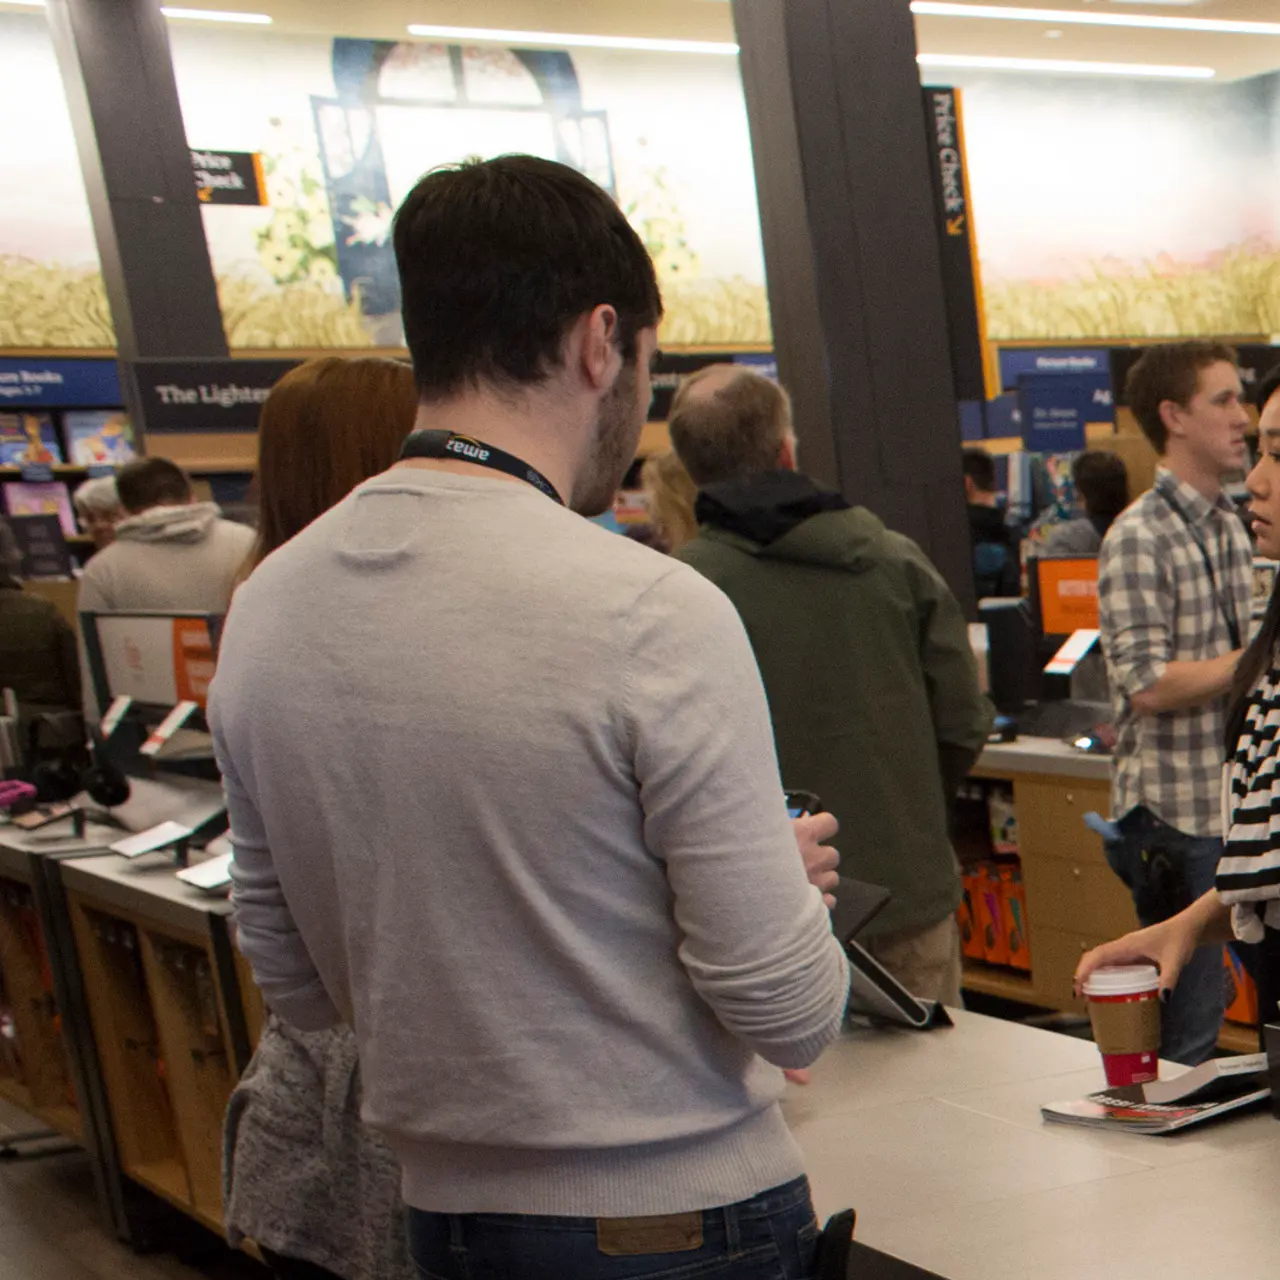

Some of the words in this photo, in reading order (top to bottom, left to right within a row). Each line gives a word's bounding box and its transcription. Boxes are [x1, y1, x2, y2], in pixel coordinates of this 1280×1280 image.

[932, 92, 956, 147] Price
[939, 147, 964, 213] Check
[155, 384, 198, 404] The
[446, 439, 490, 461] amaz
